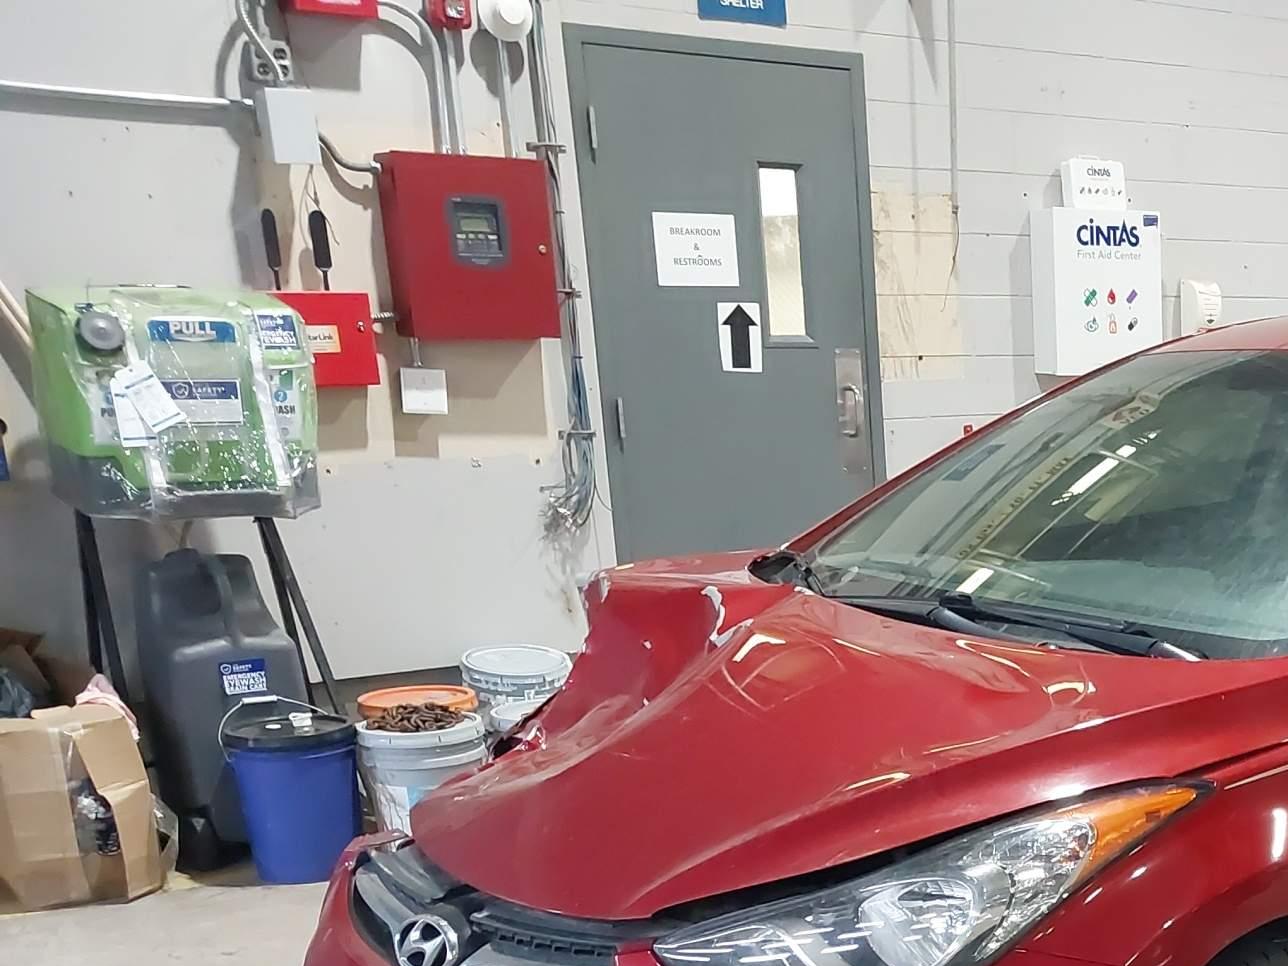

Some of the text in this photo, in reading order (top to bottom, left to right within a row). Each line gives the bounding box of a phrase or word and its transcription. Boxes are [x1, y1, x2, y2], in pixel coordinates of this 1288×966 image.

[669, 226, 721, 237] BREAKROOM
[1076, 218, 1140, 247] CINTAS
[693, 242, 700, 251] &
[1076, 249, 1141, 261] First Aid Center
[673, 257, 722, 267] RESTROOMS
[169, 320, 217, 336] PULL
[307, 333, 334, 341] tarLink
